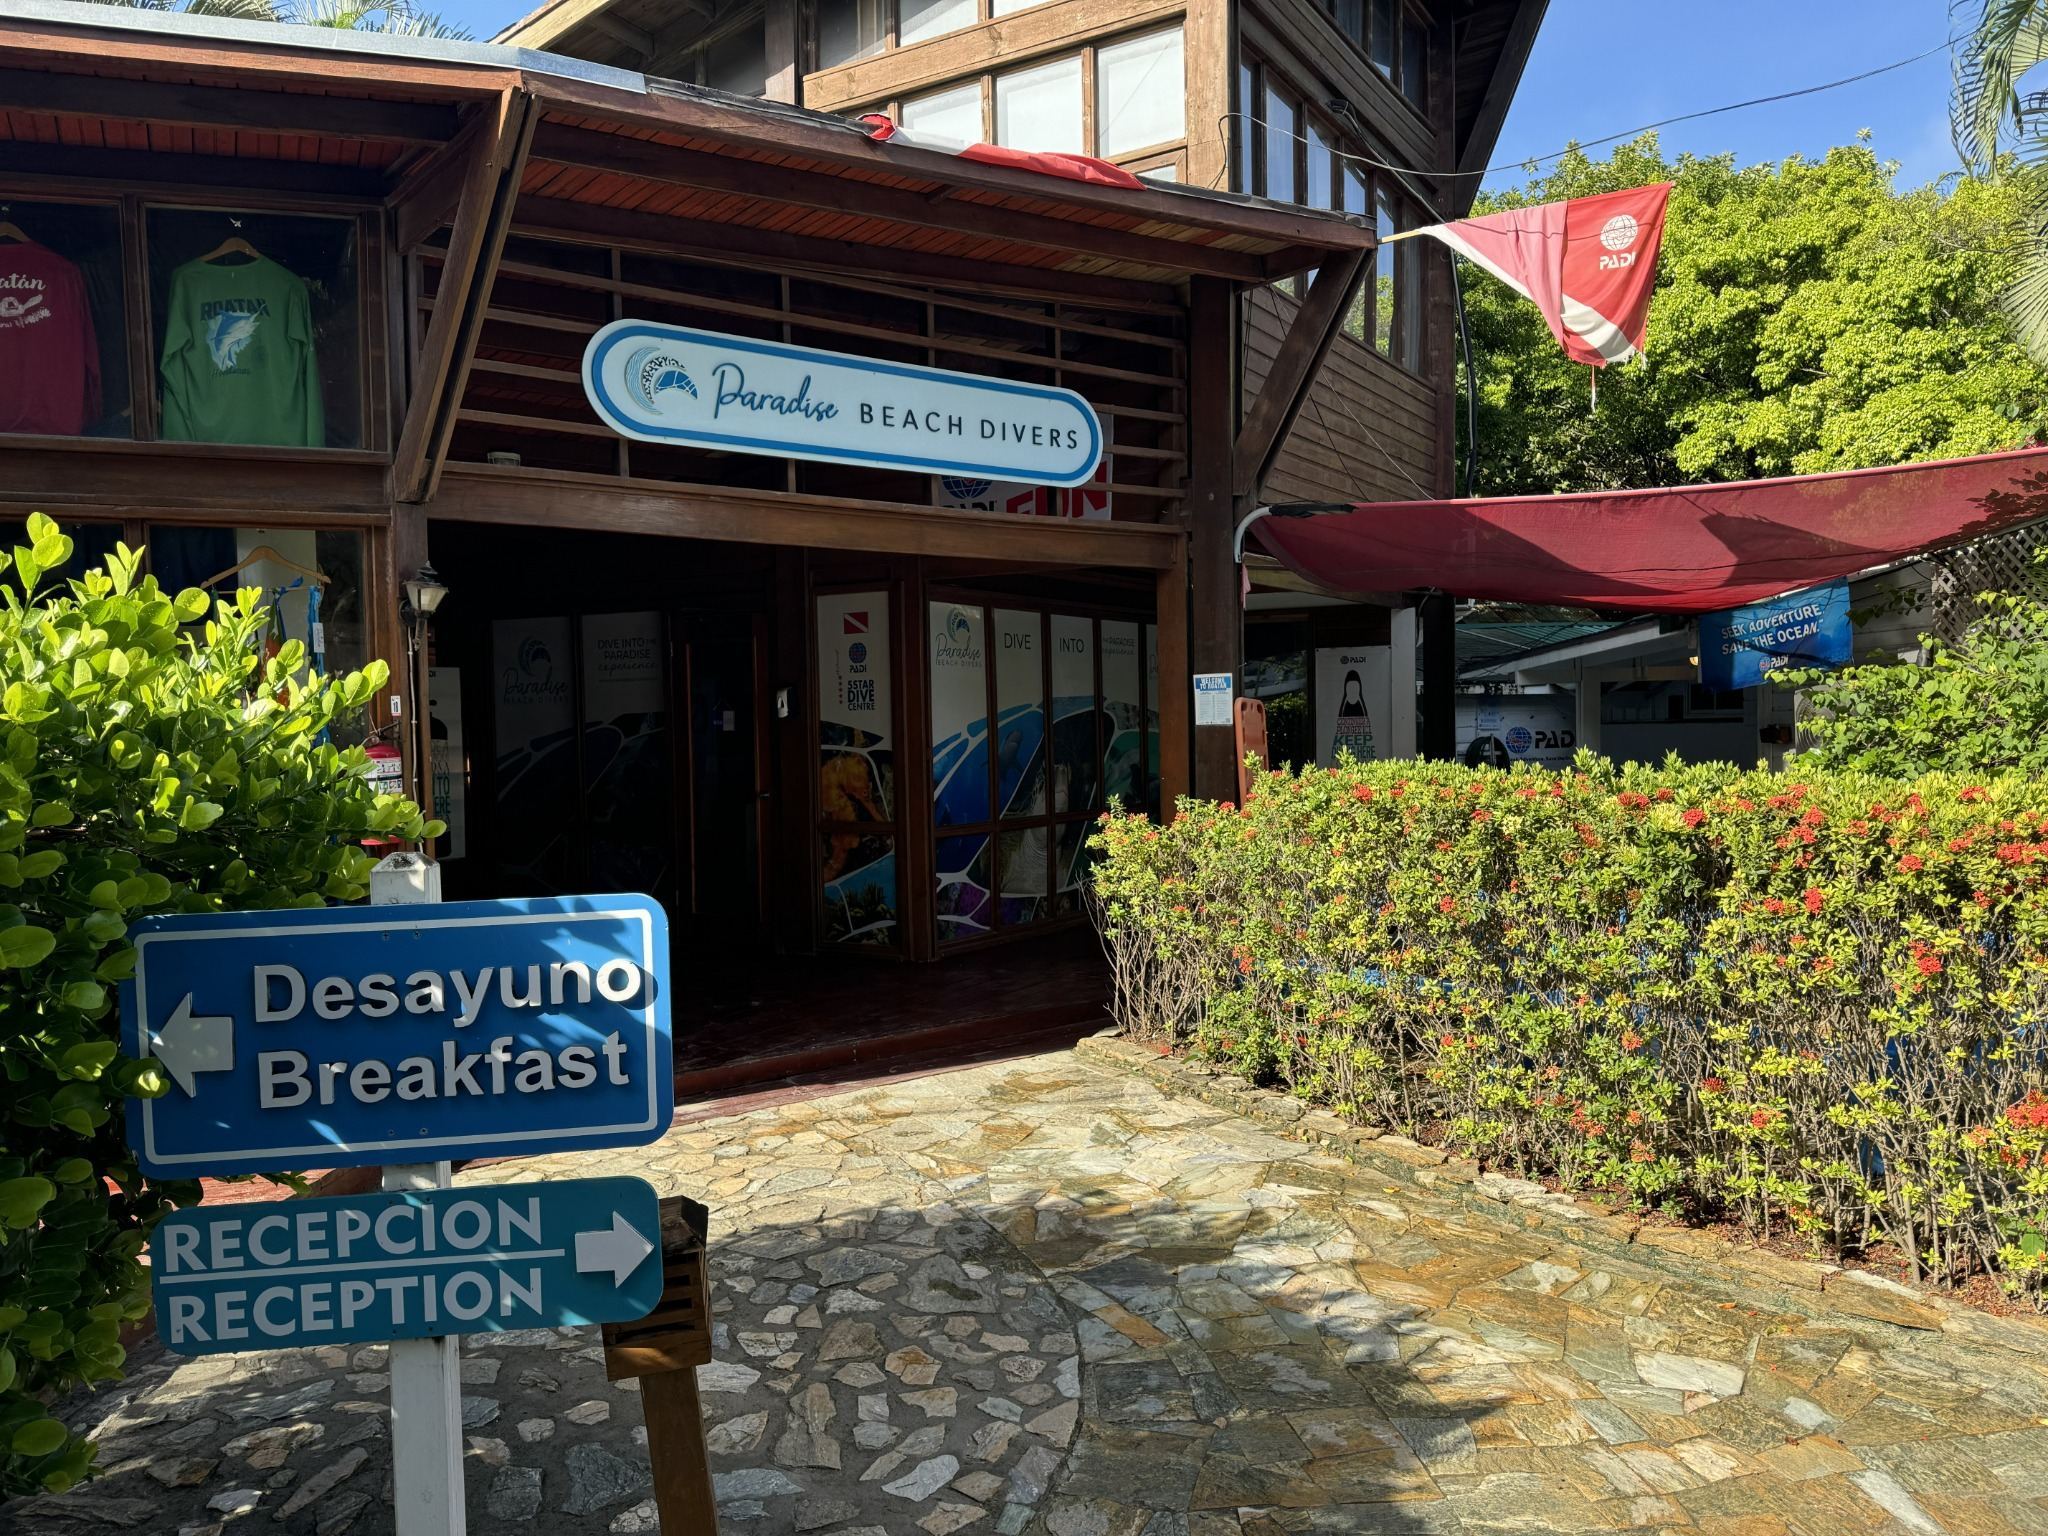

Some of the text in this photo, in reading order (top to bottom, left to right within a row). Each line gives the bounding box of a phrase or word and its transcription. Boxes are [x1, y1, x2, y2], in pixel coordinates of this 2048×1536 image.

[1600, 252, 1636, 270] PADI
[712, 363, 1078, 450] Paradise BEACH DIVERS
[1721, 623, 1747, 639] SEEK
[598, 640, 621, 649] DIVE
[622, 638, 645, 648] INTO
[935, 633, 981, 664] Paradise
[1004, 633, 1085, 653] DIVE INTO
[1721, 639, 1750, 655] SAVE
[1752, 633, 1775, 648] THE
[604, 649, 651, 660] PARADISE
[1770, 654, 1789, 668] PADI
[849, 664, 867, 673] PADI
[503, 667, 568, 704] Paradise
[847, 690, 875, 702] DIVE
[848, 702, 876, 711] CENTRE
[1333, 734, 1373, 746] KEEP
[1535, 730, 1576, 749] PAD
[253, 957, 642, 1028] Desayuno
[257, 1030, 631, 1109] Breakfast
[163, 1196, 542, 1273] RECEPCION
[168, 1267, 543, 1344] RECEPTION
